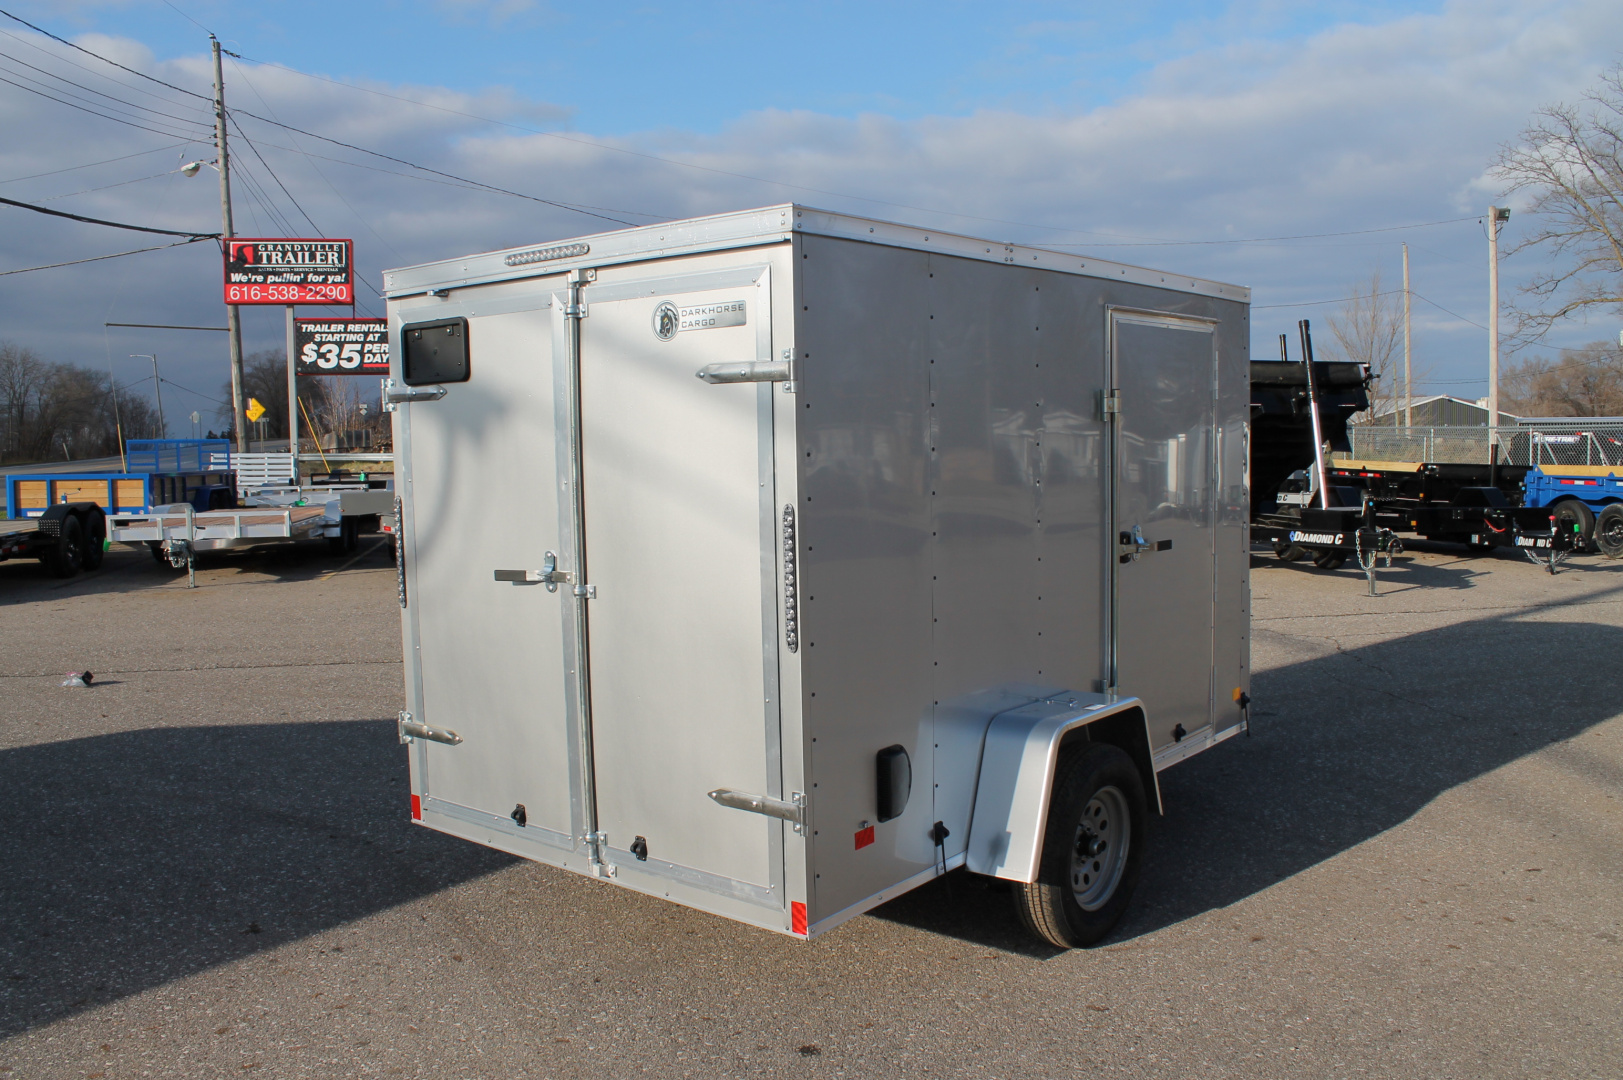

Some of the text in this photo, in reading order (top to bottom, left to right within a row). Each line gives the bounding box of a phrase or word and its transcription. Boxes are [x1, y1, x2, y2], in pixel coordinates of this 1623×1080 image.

[258, 244, 340, 252] GRANDVILLE
[258, 252, 340, 265] TRAILER
[230, 272, 346, 284] We're pullin' for ya!
[229, 285, 347, 300] 616-538-2290
[682, 304, 744, 316] DARKHORSE
[301, 324, 345, 332] TRAILER
[682, 319, 715, 328] CARGO
[314, 333, 381, 342] STARTING AT
[363, 343, 389, 353] PER
[301, 342, 362, 368] $35
[363, 353, 390, 363] DAY
[1294, 531, 1344, 544] DIAMOND C
[1518, 536, 1552, 547] DIAMND C
